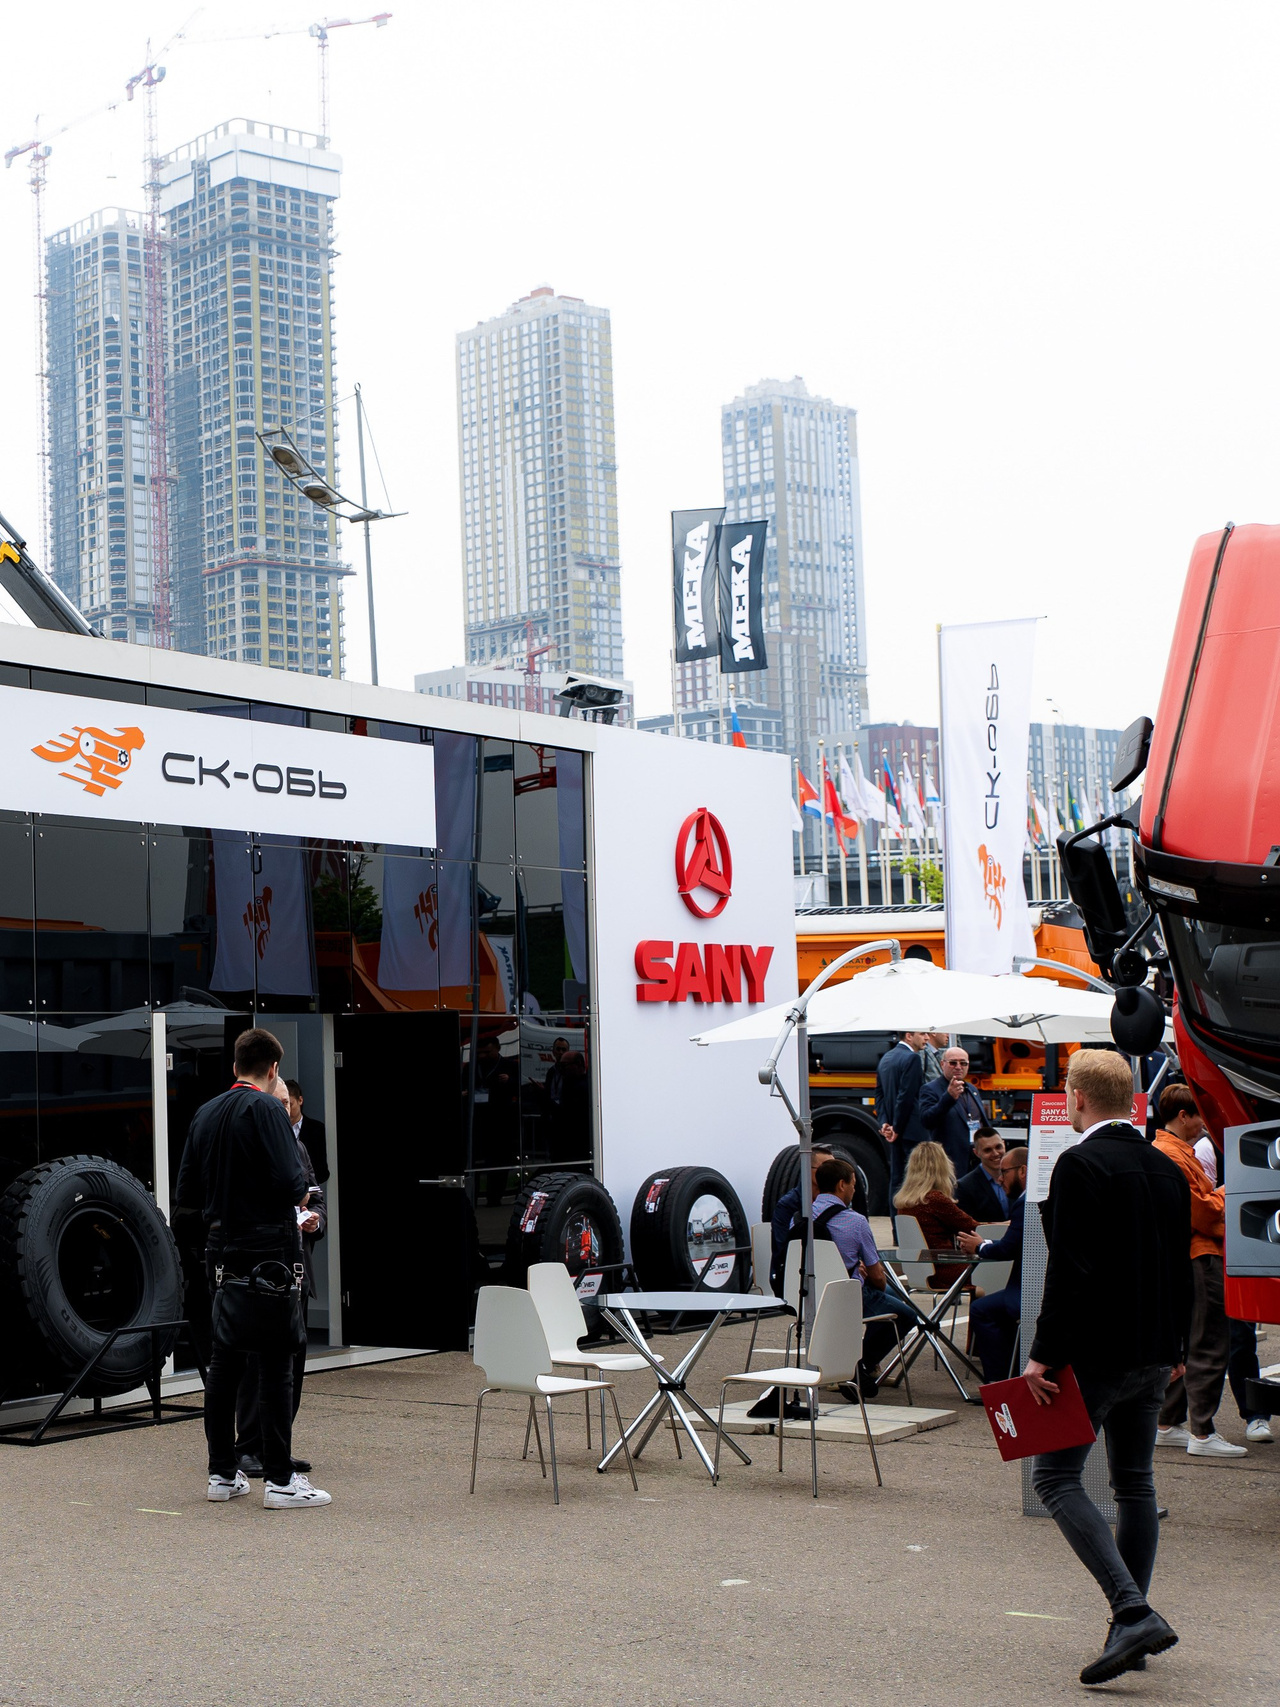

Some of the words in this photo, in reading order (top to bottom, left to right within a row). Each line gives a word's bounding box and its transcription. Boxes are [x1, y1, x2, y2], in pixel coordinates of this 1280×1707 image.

[682, 520, 710, 650] MEKA
[730, 534, 755, 663] MEKA
[161, 751, 348, 801] СК-ОБЬ
[984, 662, 1002, 830] СК-ОБЬ
[634, 939, 775, 1004] SANY
